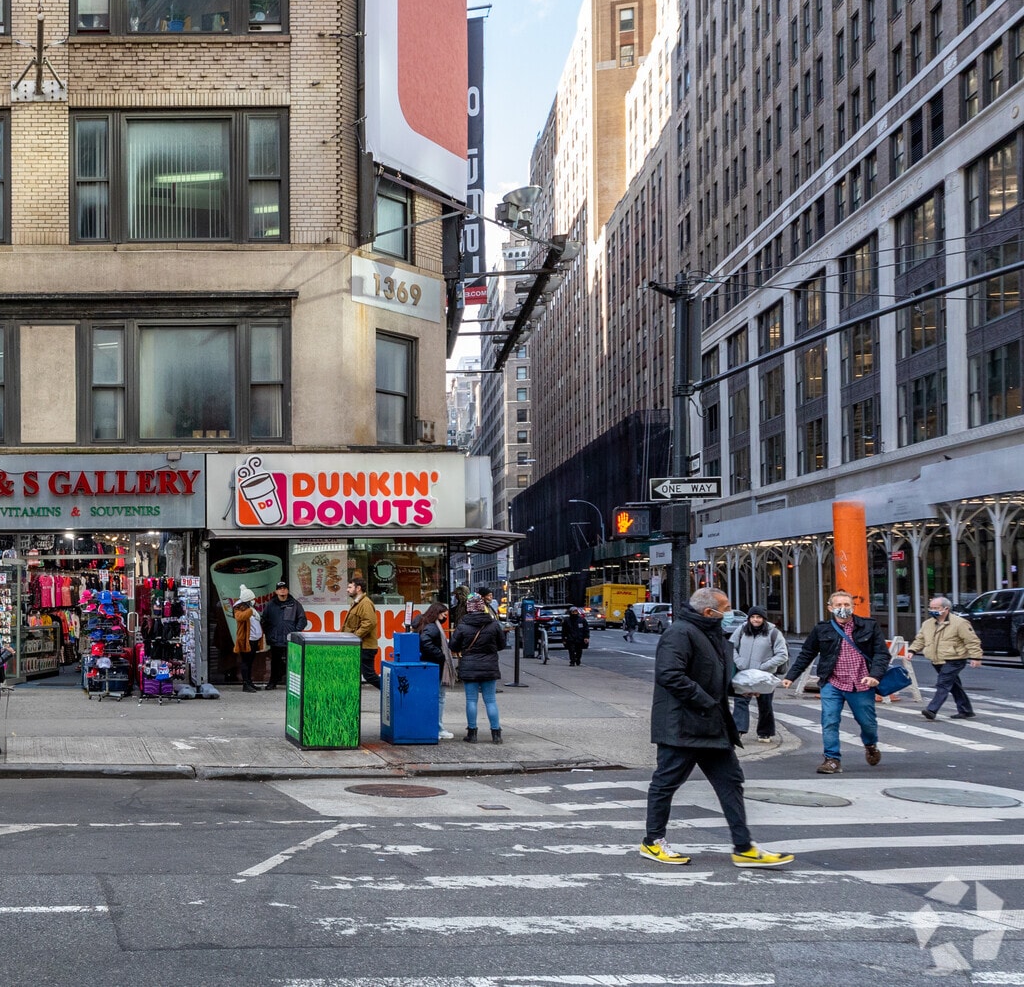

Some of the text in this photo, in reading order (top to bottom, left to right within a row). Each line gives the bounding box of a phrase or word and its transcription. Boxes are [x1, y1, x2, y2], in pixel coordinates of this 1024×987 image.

[373, 273, 422, 306] 1369
[22, 471, 40, 497] S
[47, 470, 201, 497] GALLERY
[292, 470, 440, 498] DUNKIN'
[661, 484, 713, 493] ONE WAY
[0, 505, 161, 518] VITAMINS & SOUVENIRS
[292, 499, 434, 526] DONUTS
